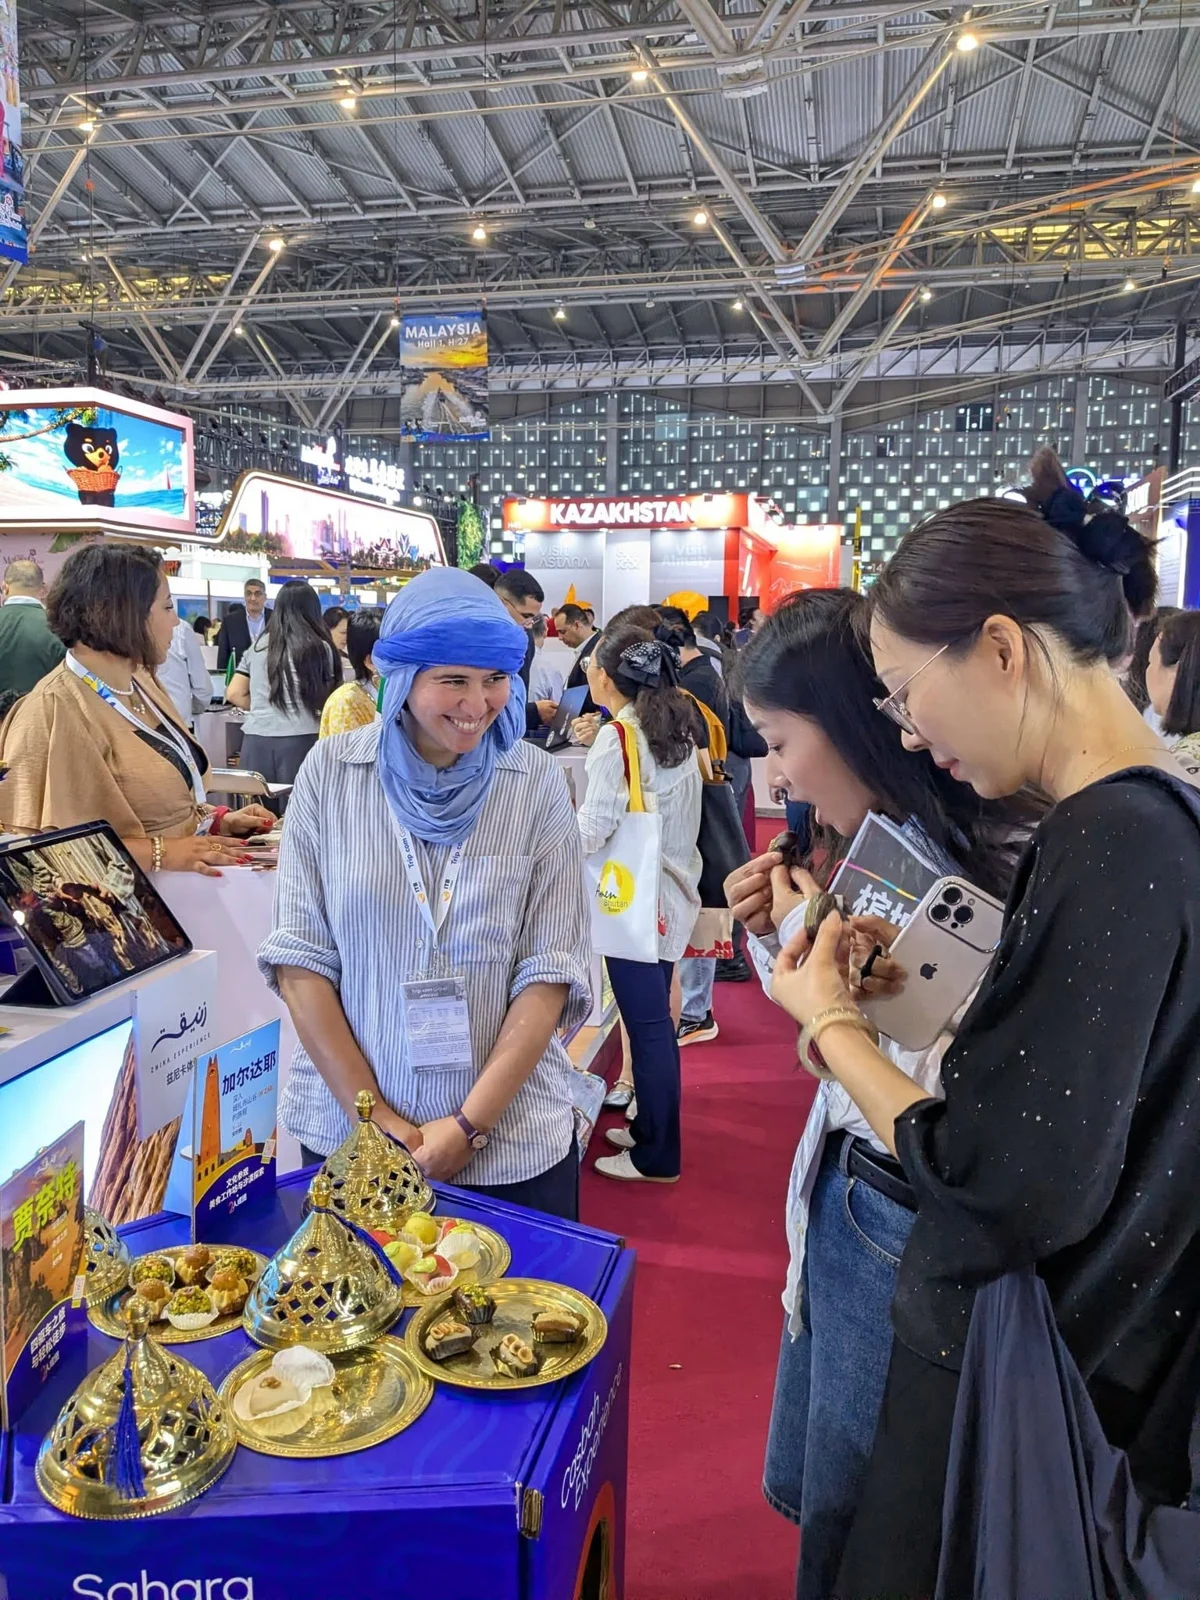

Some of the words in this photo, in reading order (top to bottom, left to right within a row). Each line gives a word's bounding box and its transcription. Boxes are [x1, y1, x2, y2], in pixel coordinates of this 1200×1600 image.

[405, 322, 481, 338] MALAYSIA
[418, 339, 436, 348] Hall
[551, 501, 700, 524] KAZAKHSTAN
[412, 882, 420, 893] ITB
[443, 879, 451, 890] ITB
[173, 1032, 211, 1060] EXPERIENCE
[221, 1050, 277, 1096] 加尔达耶
[12, 1160, 78, 1253] 贾奈特
[561, 1390, 600, 1510] Casbah
[574, 1361, 623, 1513] Experience
[72, 1568, 255, 1600] Sahara
